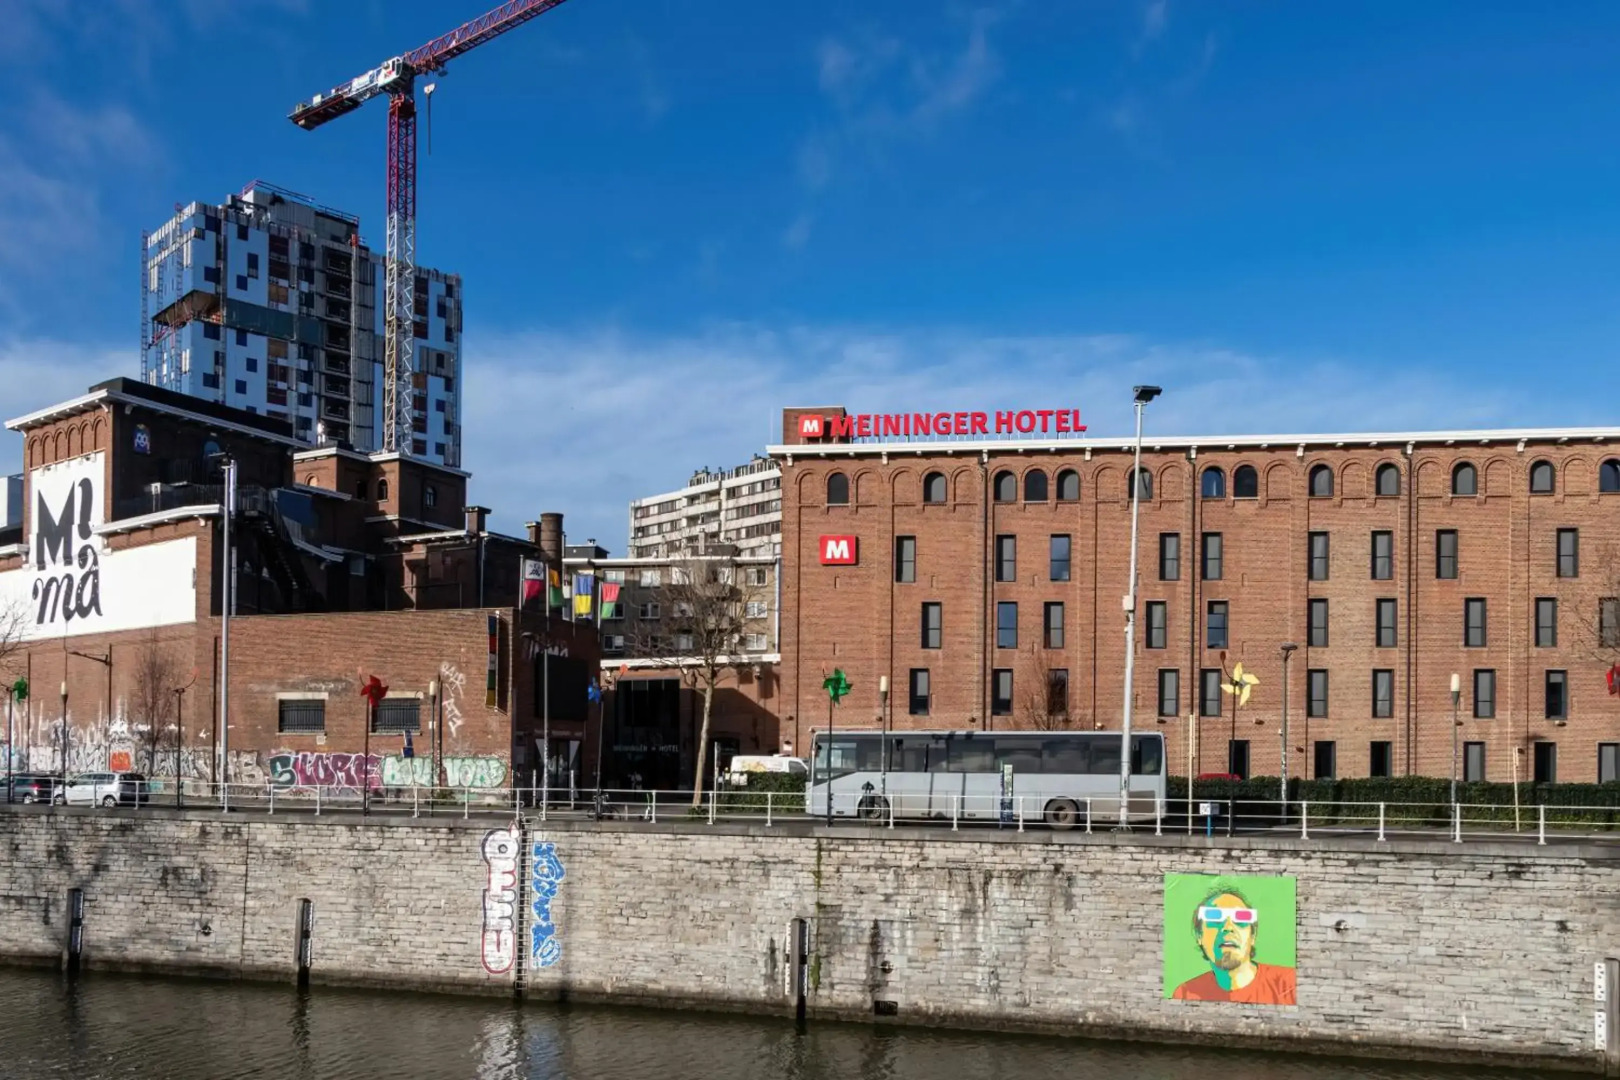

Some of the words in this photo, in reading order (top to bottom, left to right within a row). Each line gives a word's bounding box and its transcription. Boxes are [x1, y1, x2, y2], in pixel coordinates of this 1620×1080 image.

[803, 419, 819, 432] M
[830, 412, 988, 437] MEININGER
[995, 409, 1087, 434] HOTEL
[826, 539, 849, 559] M
